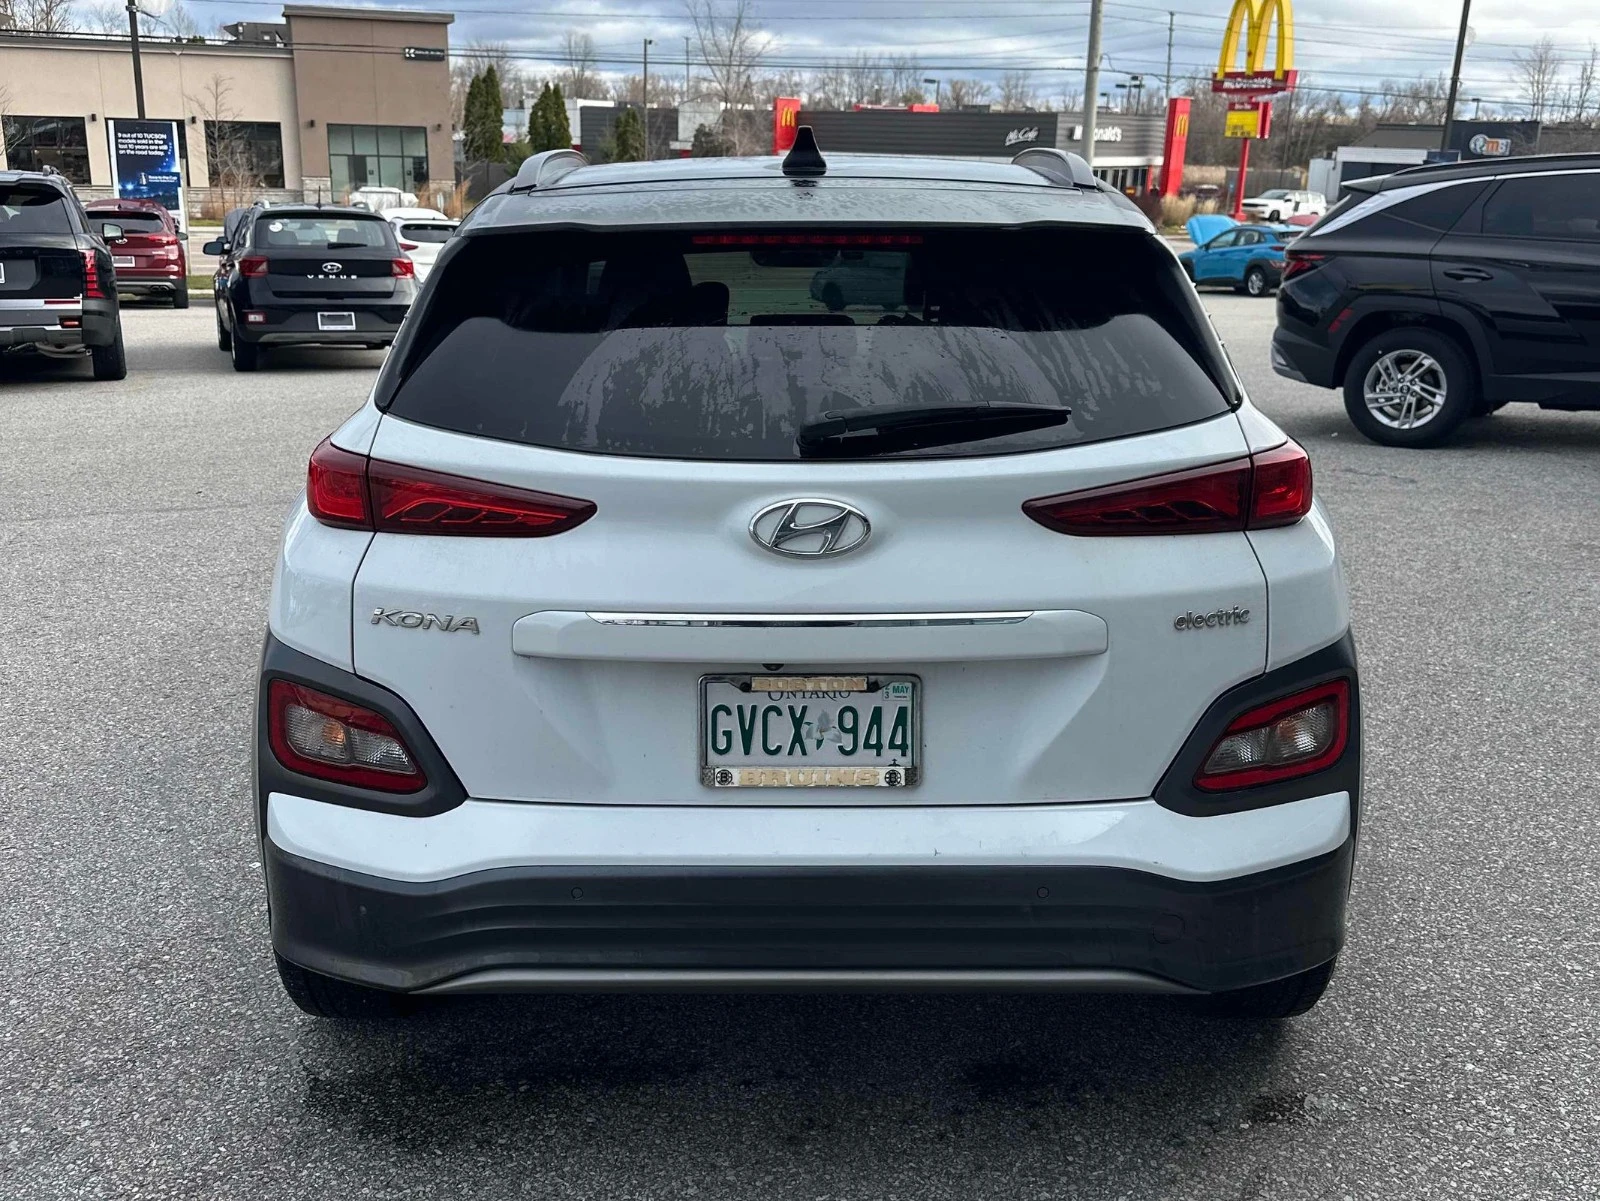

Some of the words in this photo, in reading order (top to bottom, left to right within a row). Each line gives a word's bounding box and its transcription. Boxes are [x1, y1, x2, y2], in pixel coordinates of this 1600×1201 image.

[371, 607, 480, 635] KONA
[1174, 604, 1251, 631] electric
[754, 678, 867, 690] BOSTON
[892, 685, 909, 694] MAY
[711, 704, 808, 756] GVCX
[837, 705, 909, 757] 944
[739, 769, 880, 786] BRUINS
